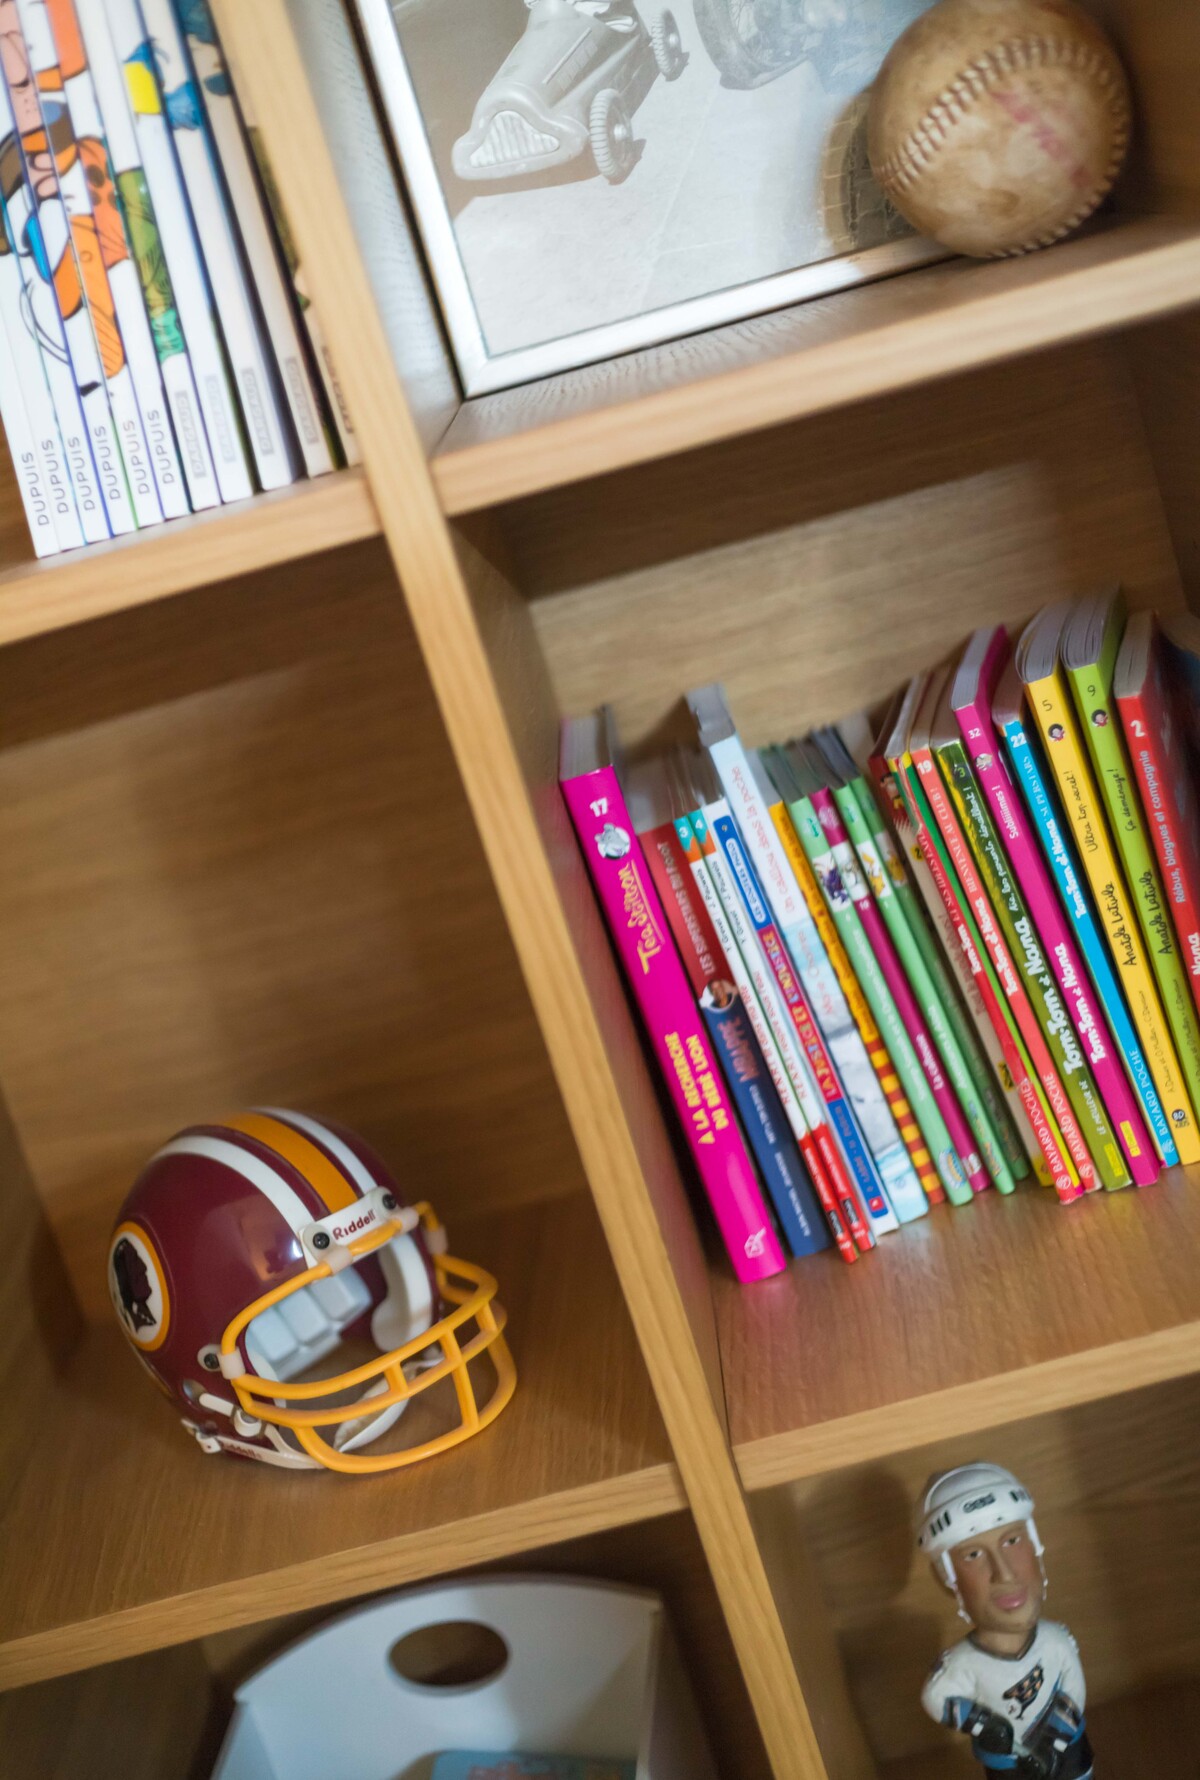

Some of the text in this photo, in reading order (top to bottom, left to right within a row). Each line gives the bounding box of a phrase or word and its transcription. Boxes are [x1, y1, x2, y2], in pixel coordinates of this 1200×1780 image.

[242, 370, 272, 453] DARGAUD
[147, 409, 174, 484] DUPUIS
[176, 392, 205, 477] DARGAUD
[41, 439, 68, 513] DUPUIS
[67, 436, 95, 510] DUPUIS
[93, 425, 120, 499] DUPUIS
[122, 420, 149, 494] DUPUIS
[21, 452, 49, 525] DUPUIS
[1042, 698, 1053, 712] 5
[1087, 684, 1096, 698] 9
[967, 726, 981, 739] 32
[1011, 733, 1027, 747] 22
[1131, 719, 1145, 738] 2
[731, 766, 754, 802] poche
[917, 760, 931, 775] 19
[1023, 756, 1047, 816] SUPERSTARS
[589, 797, 610, 818] 17
[744, 804, 757, 818] la
[932, 793, 948, 820] CLUB
[944, 822, 954, 834] AU
[966, 792, 988, 837] déraillent
[1076, 804, 1088, 820] top
[1139, 750, 1185, 902] Rébus, blagues et compagnie
[751, 820, 769, 848] dans
[1045, 818, 1063, 854] Nana
[1082, 822, 1098, 852] Ultra
[767, 852, 787, 892] caillou
[950, 837, 976, 892] BIENVENUE
[985, 840, 1006, 876] parents
[614, 863, 647, 926] Stilton
[942, 888, 953, 905] SES
[999, 877, 1010, 893] les
[1063, 866, 1086, 917] Tom-Tom
[675, 891, 705, 954] SUPERSTARS
[971, 897, 992, 932] Nana
[1146, 912, 1172, 955] Anatole
[699, 954, 713, 974] LES
[954, 924, 981, 973] Tom-Tom
[1013, 917, 1043, 974] Nana
[1053, 943, 1077, 987] Nana
[1113, 925, 1136, 965] Anatole
[989, 944, 1017, 994] Tom-Tom
[764, 933, 836, 1096] LA JUSTICE ET L'INJUSTICE
[1042, 988, 1082, 1073] Tom-Tom
[1075, 997, 1105, 1062] Tom-Tom
[665, 1033, 699, 1106] RECHERCHE
[718, 1015, 760, 1083] MBAPPÉ
[686, 1034, 728, 1129] DU BÉBÉ LION
[932, 1074, 943, 1089] La
[1078, 1080, 1088, 1089] DE
[1129, 1050, 1168, 1135] BAYARD POCHE
[692, 1108, 709, 1129] LA
[1020, 1082, 1062, 1172] BAYARD POCHE
[1043, 1073, 1085, 1161] BAYARD POCHE
[1083, 1090, 1101, 1124] MEILLEUR
[1096, 1126, 1106, 1135] LE
[332, 1207, 377, 1241] Riddell
